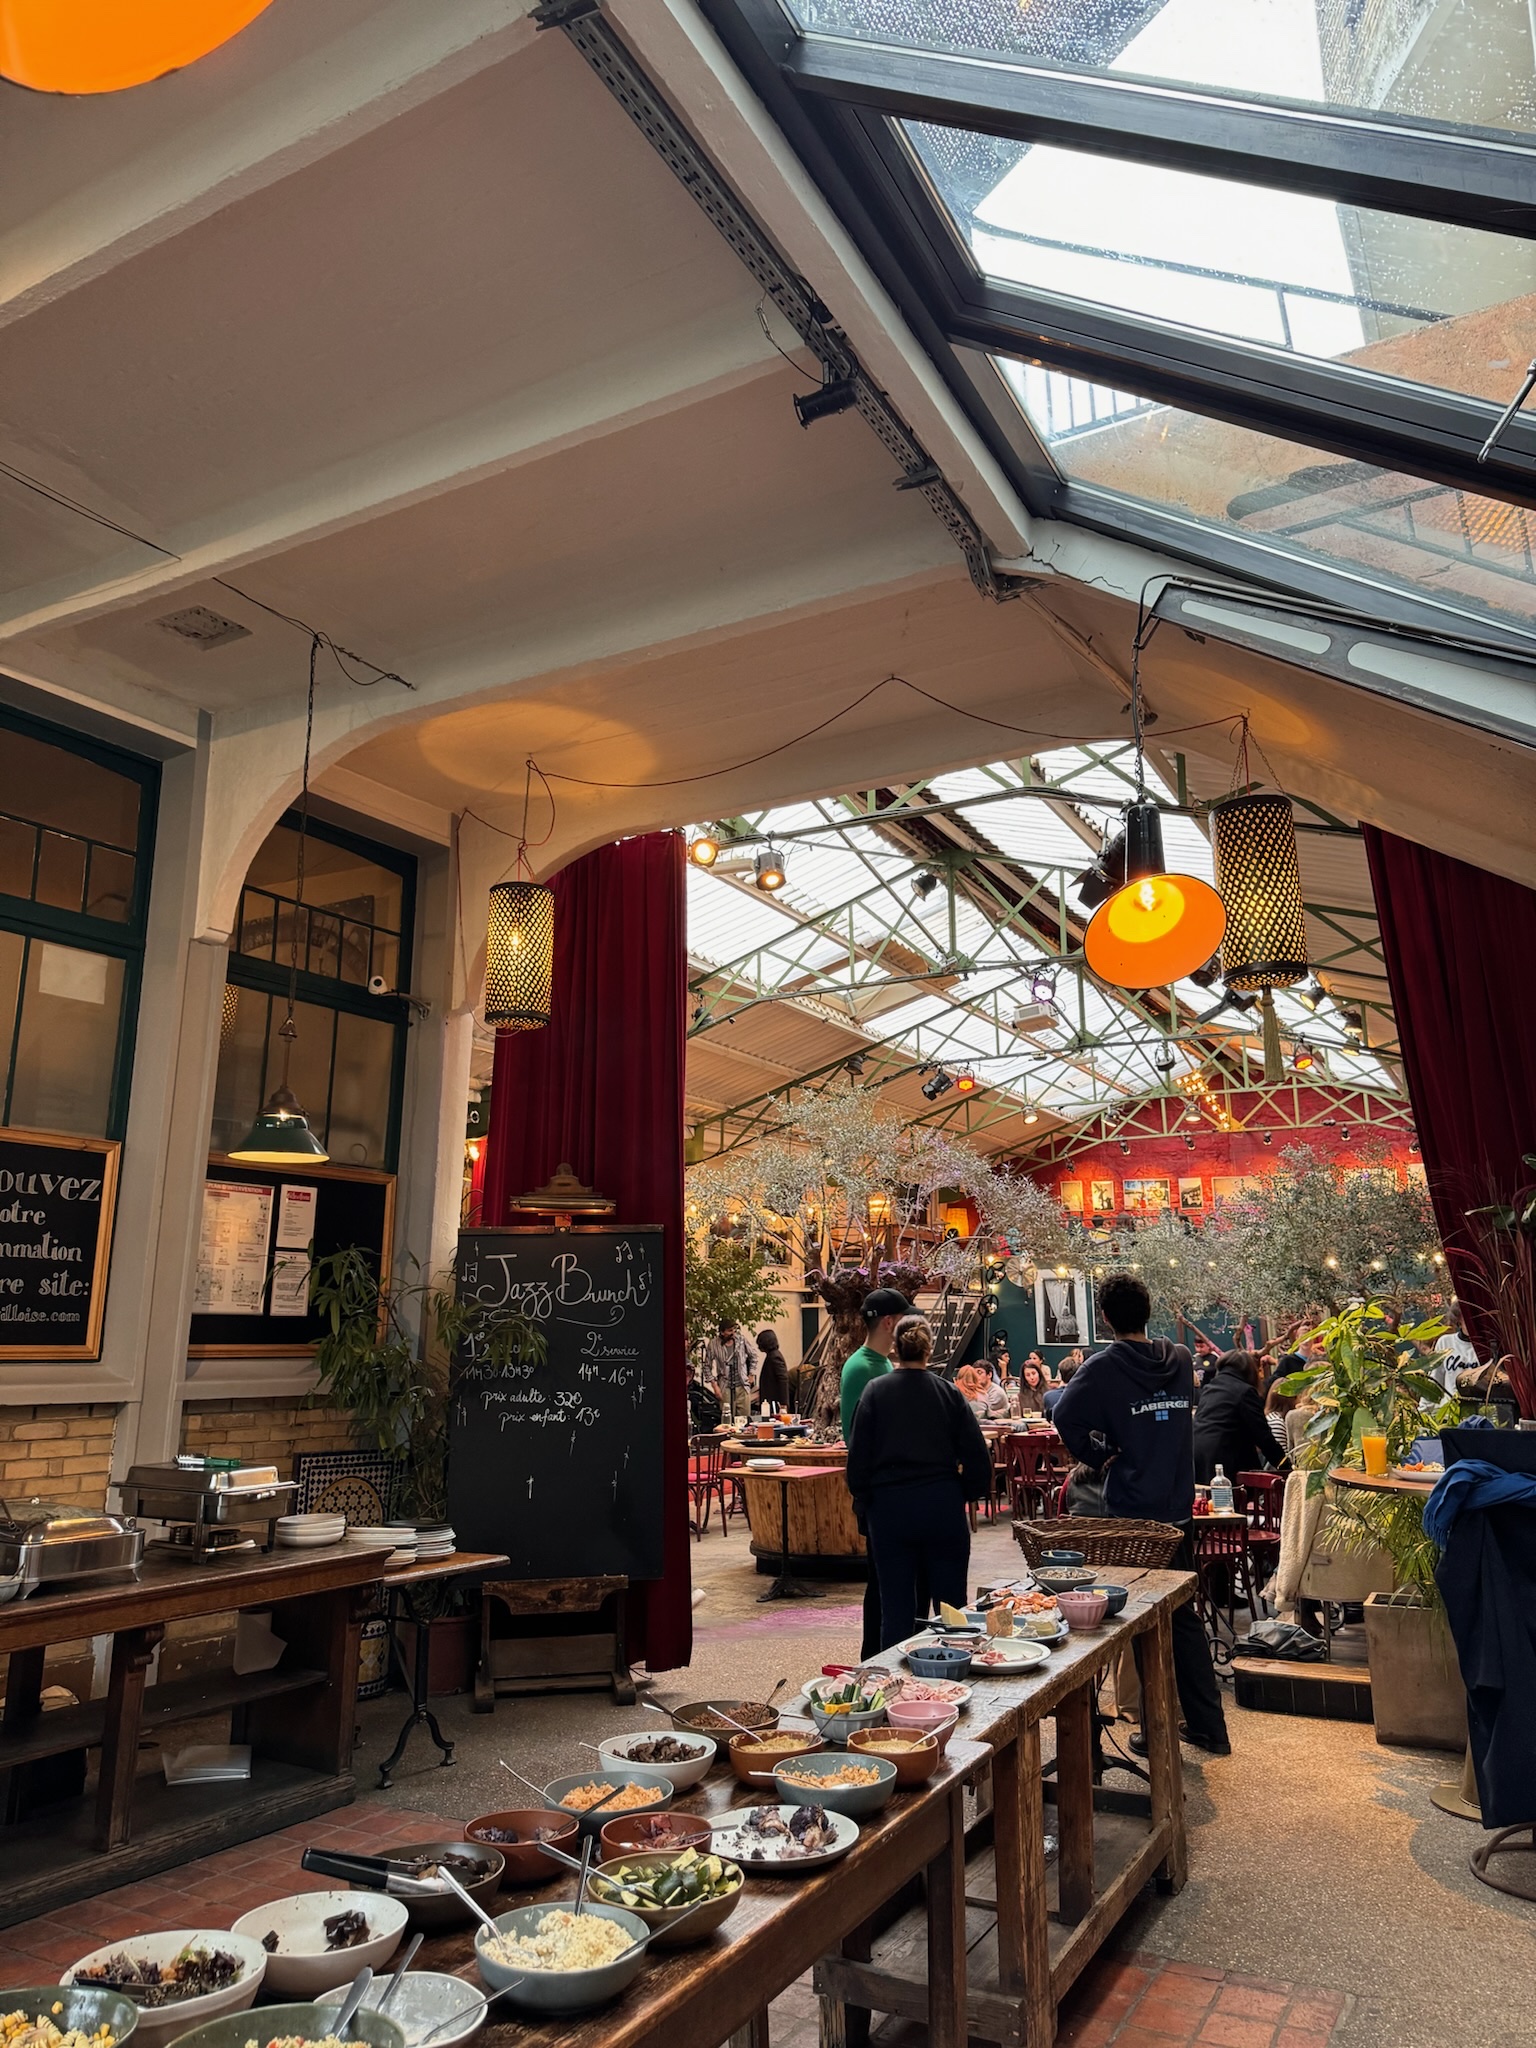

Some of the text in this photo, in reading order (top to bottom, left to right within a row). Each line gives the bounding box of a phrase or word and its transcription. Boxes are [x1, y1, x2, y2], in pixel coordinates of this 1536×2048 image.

[0, 1199, 46, 1225] otre
[38, 1269, 90, 1297] site:
[476, 1253, 650, 1320] Jazz Brunch
[0, 1303, 80, 1323] illoise.com
[600, 1345, 640, 1357] service
[480, 1390, 508, 1411] prix
[1131, 1400, 1190, 1416] LABERGE
[498, 1410, 526, 1432] prix
